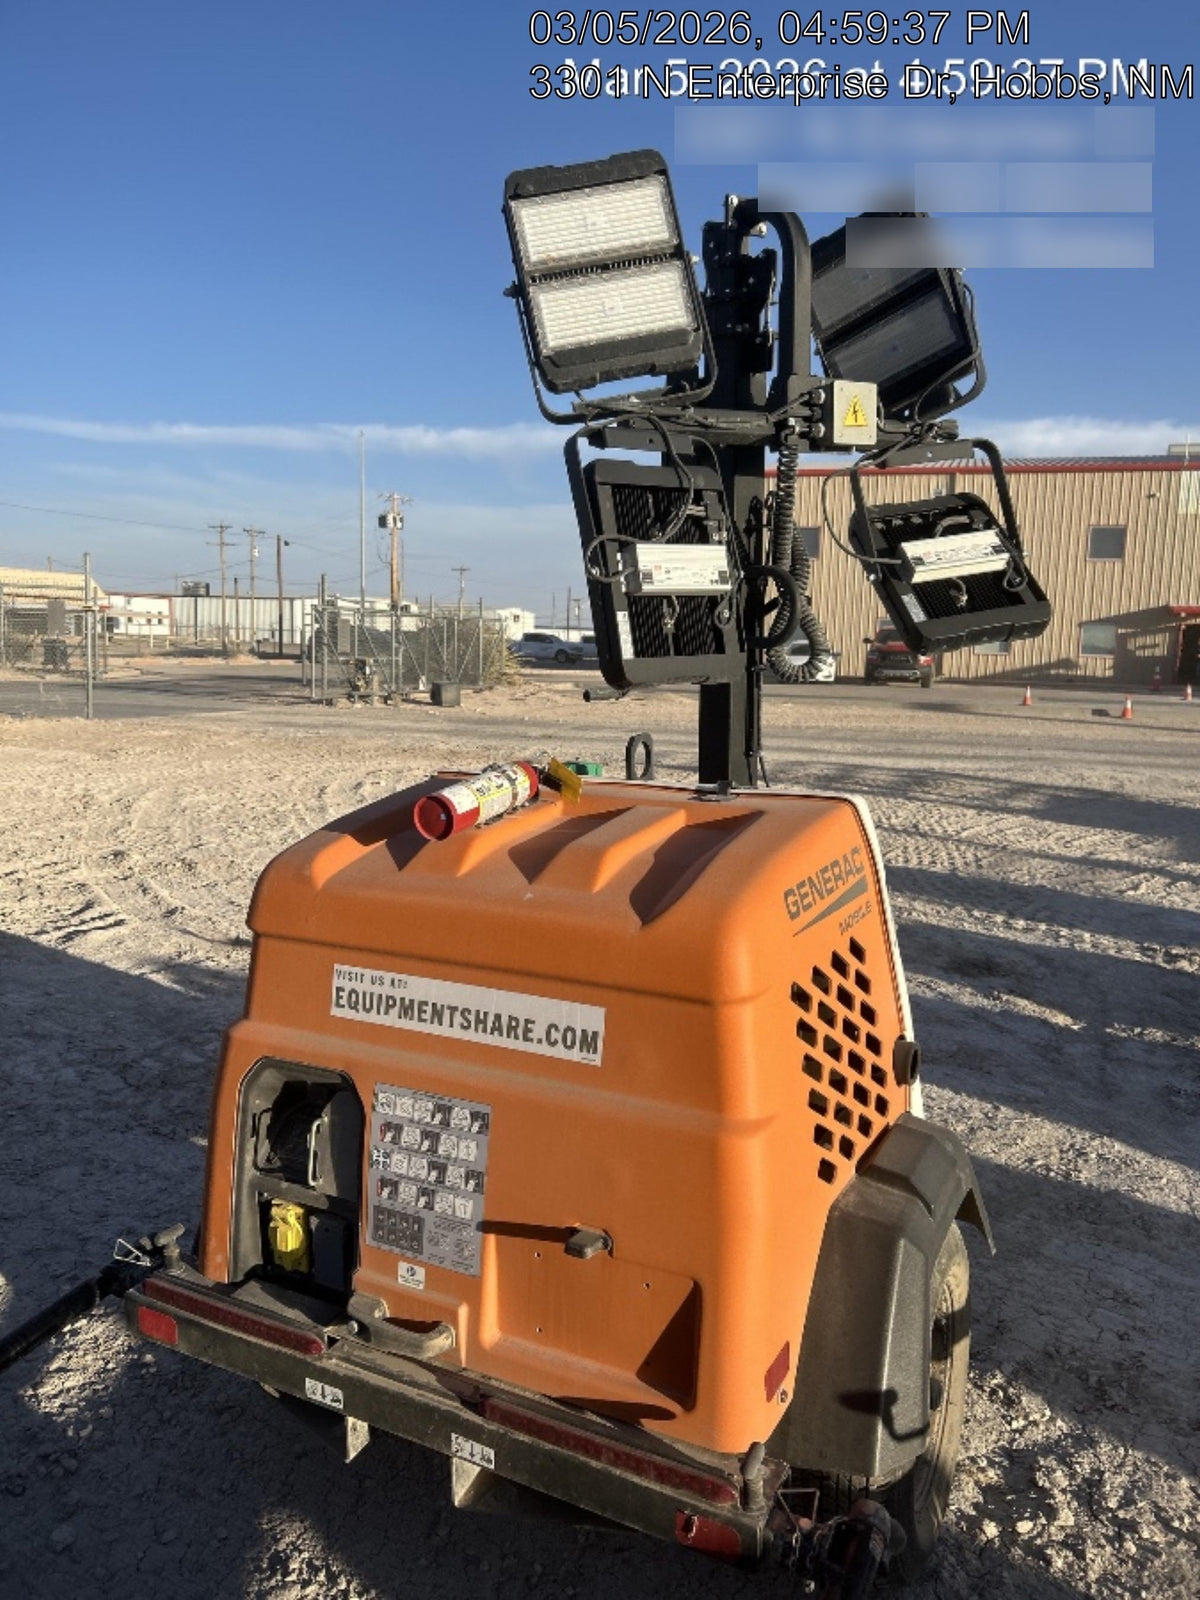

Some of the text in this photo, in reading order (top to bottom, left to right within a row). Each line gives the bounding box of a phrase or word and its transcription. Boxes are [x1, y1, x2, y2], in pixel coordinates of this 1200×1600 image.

[783, 846, 865, 921] GENERAC
[336, 968, 365, 984] VISIT
[371, 974, 385, 986] US
[334, 986, 600, 1055] EQUIPMENTSHARE.COM
